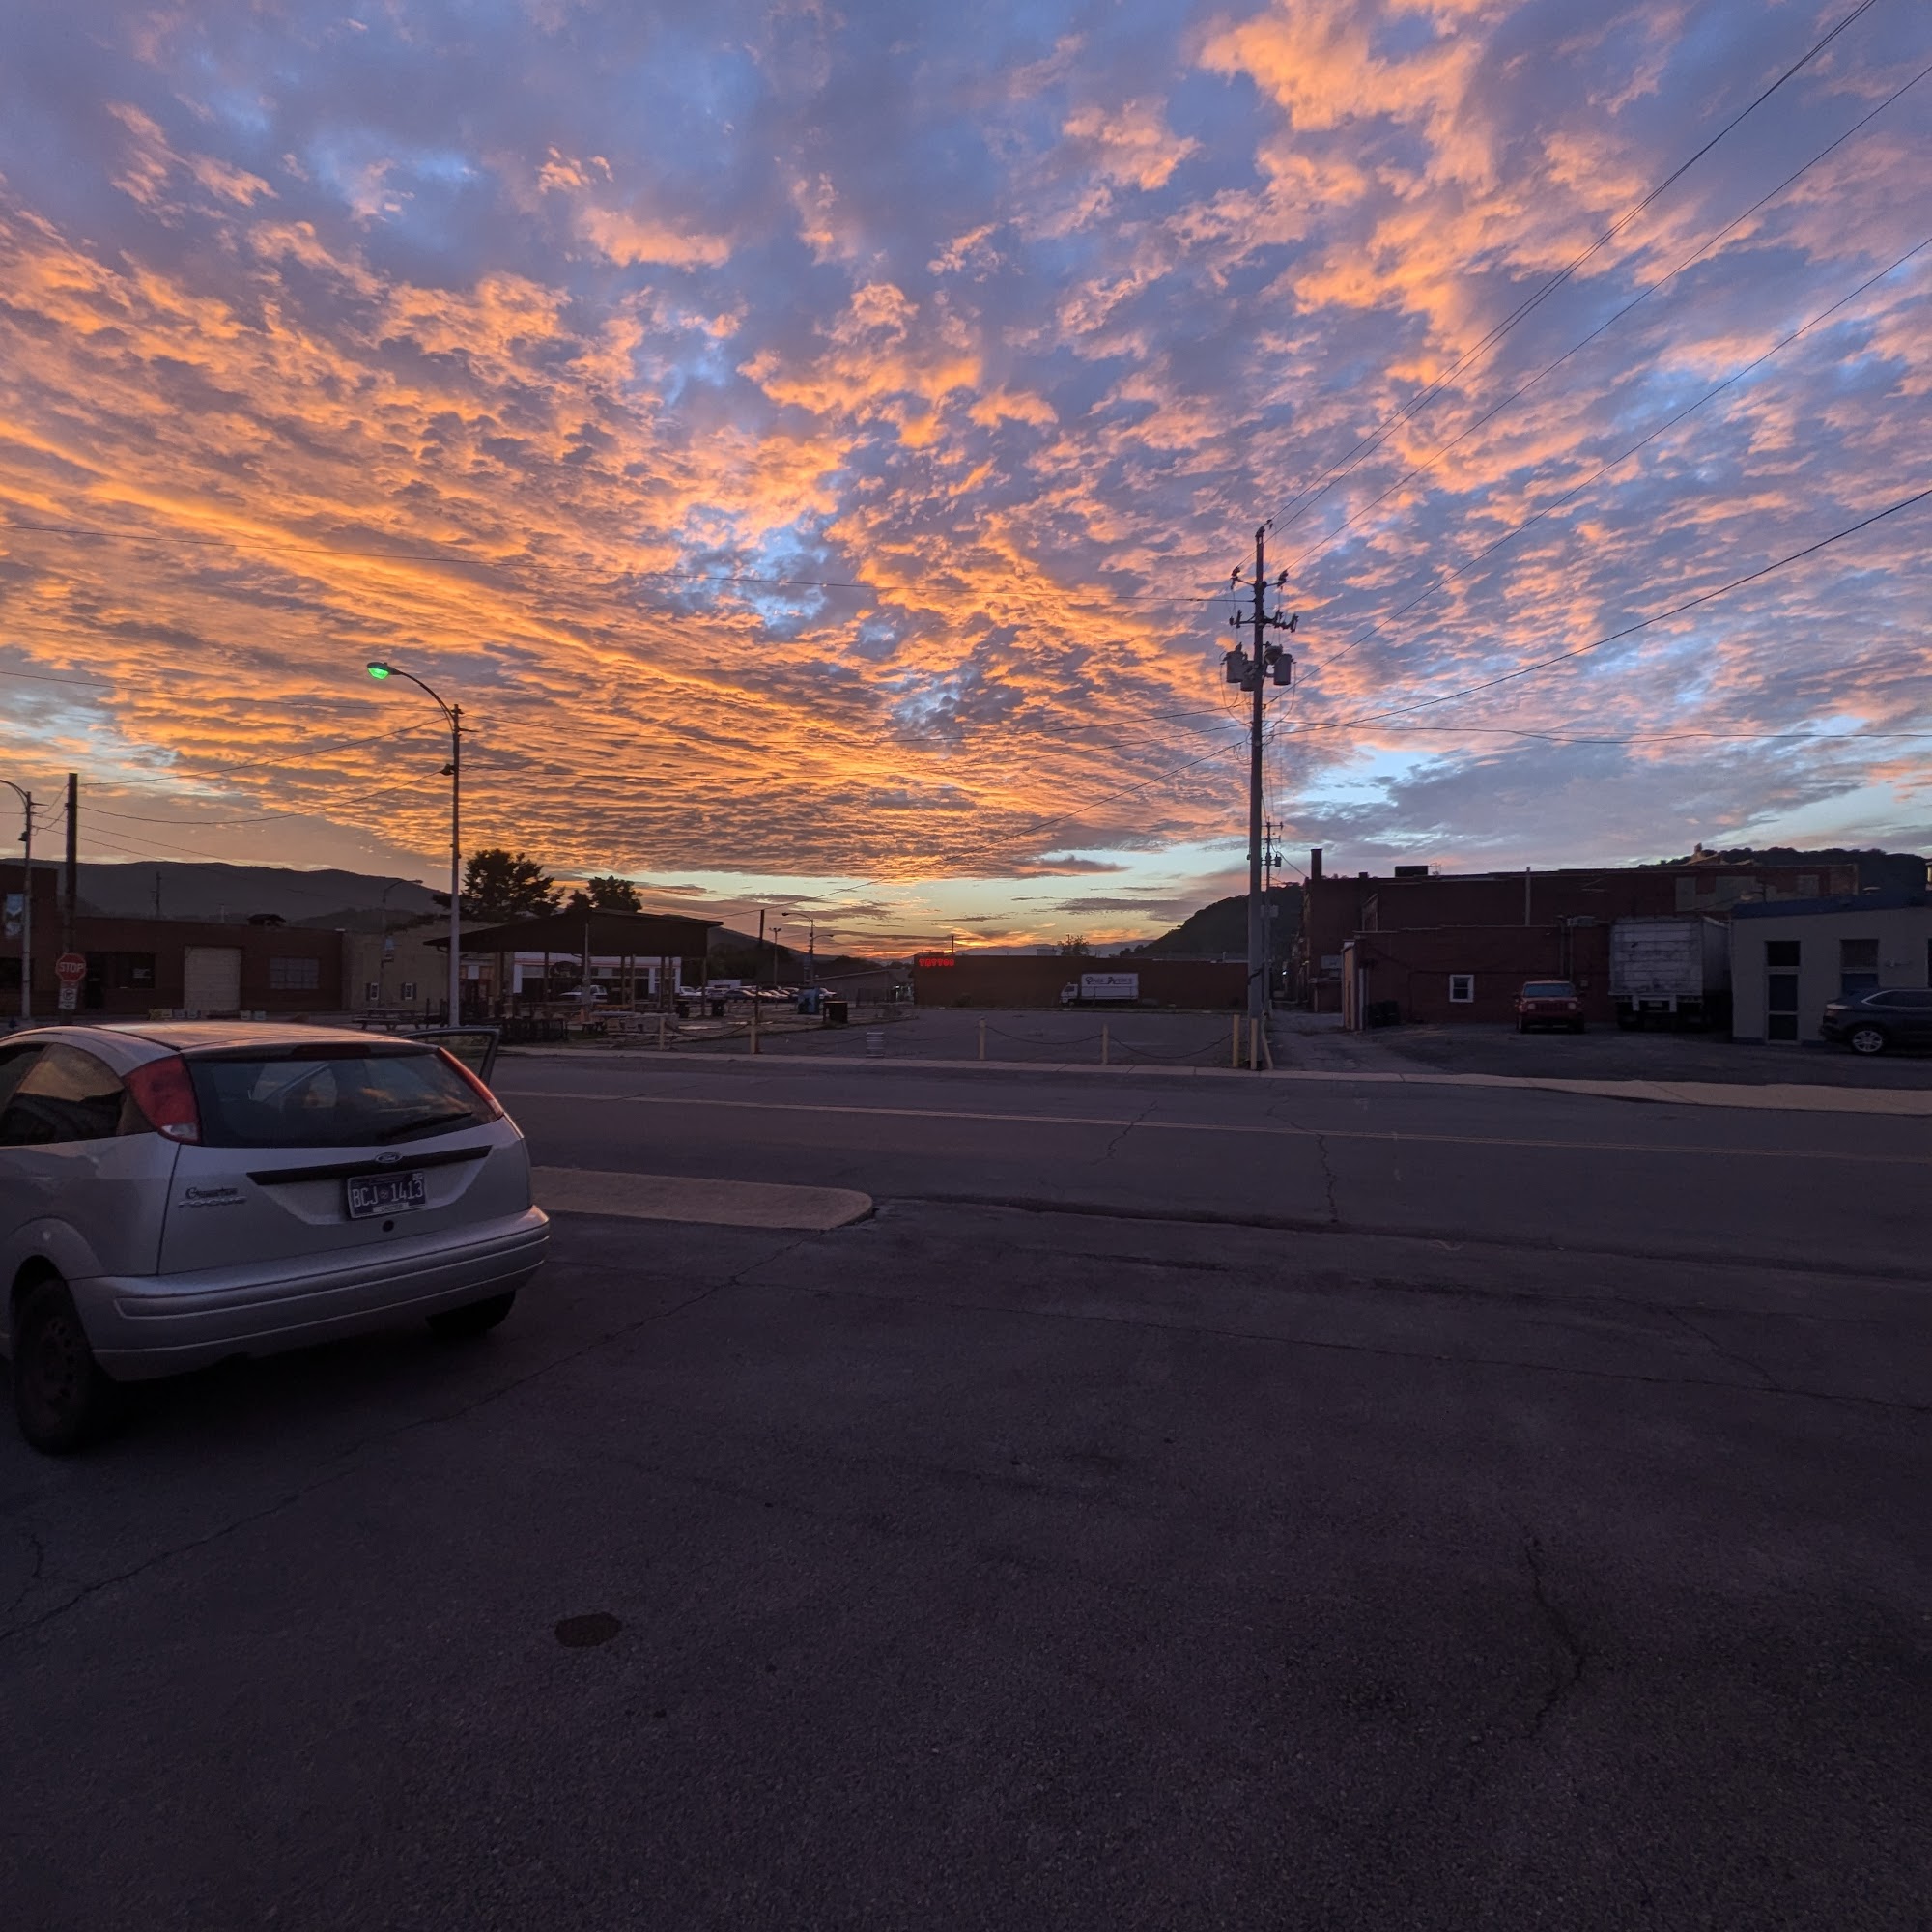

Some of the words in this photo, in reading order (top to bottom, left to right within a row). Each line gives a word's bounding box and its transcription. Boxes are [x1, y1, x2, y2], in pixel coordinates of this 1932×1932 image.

[60, 962, 84, 973] STOP
[919, 958, 954, 967] TATTOO
[352, 1186, 378, 1208] BCJ
[390, 1180, 423, 1202] 1413
